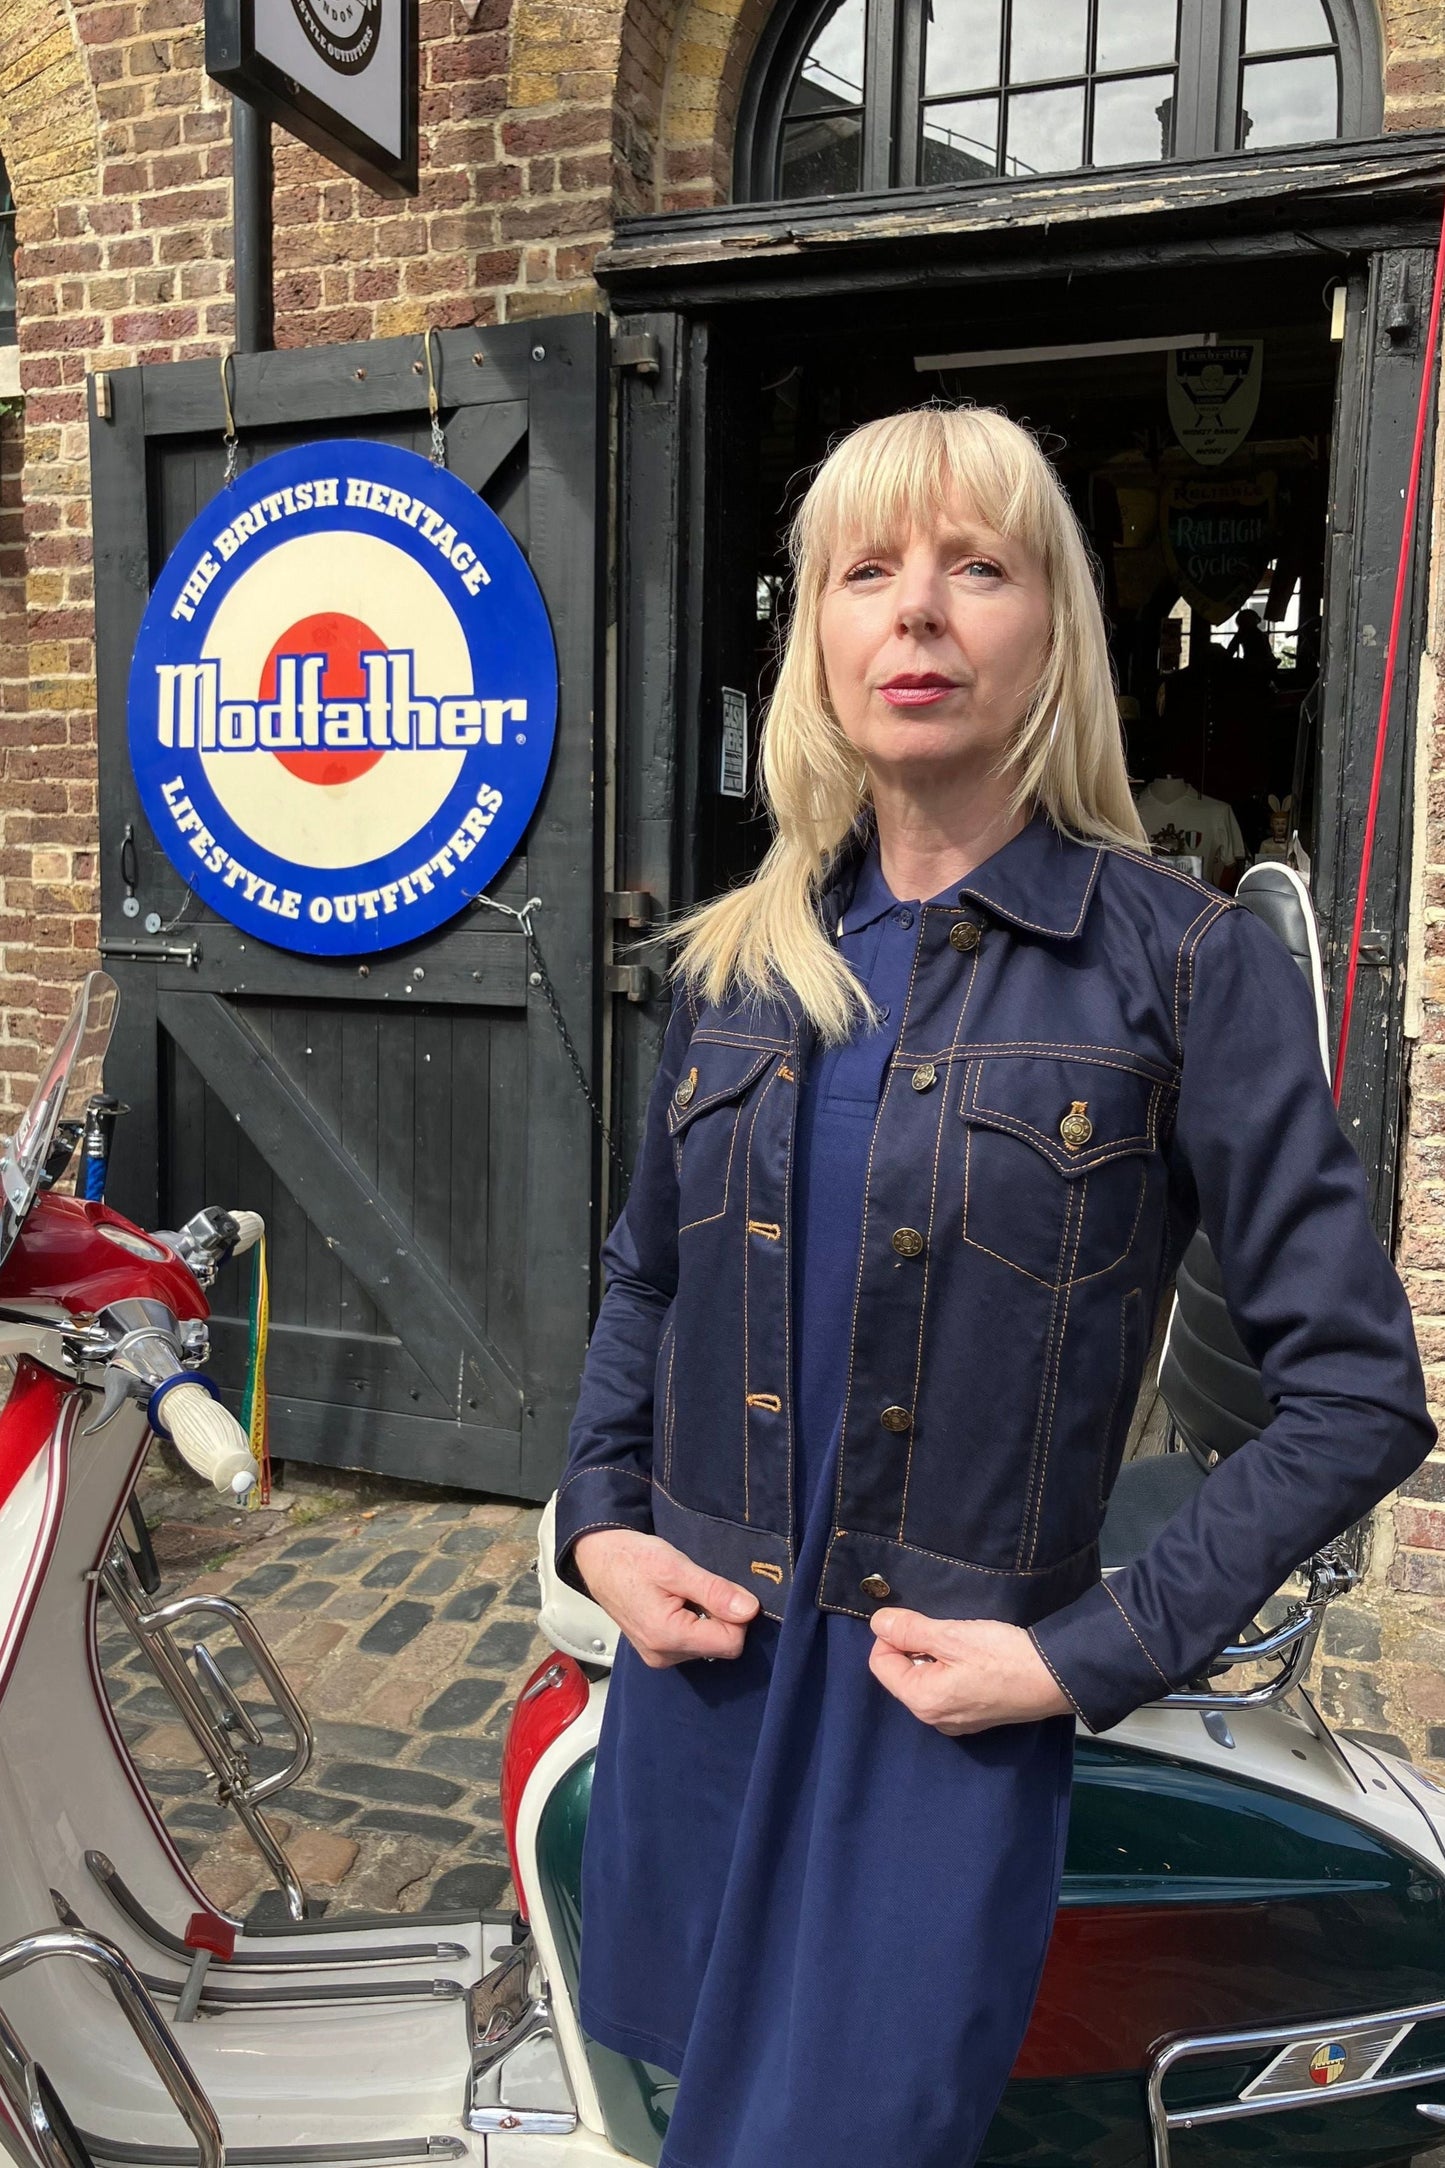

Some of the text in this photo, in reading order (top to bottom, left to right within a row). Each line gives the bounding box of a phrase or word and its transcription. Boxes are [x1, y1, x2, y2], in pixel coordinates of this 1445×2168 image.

[297, 0, 327, 49] STYLE
[318, 0, 353, 23] NDON
[171, 477, 491, 623] THE BRITISH HERITAGE
[1177, 516, 1262, 551] RALEIGH
[161, 775, 503, 924] LIFESTYLE OUTFITTERS
